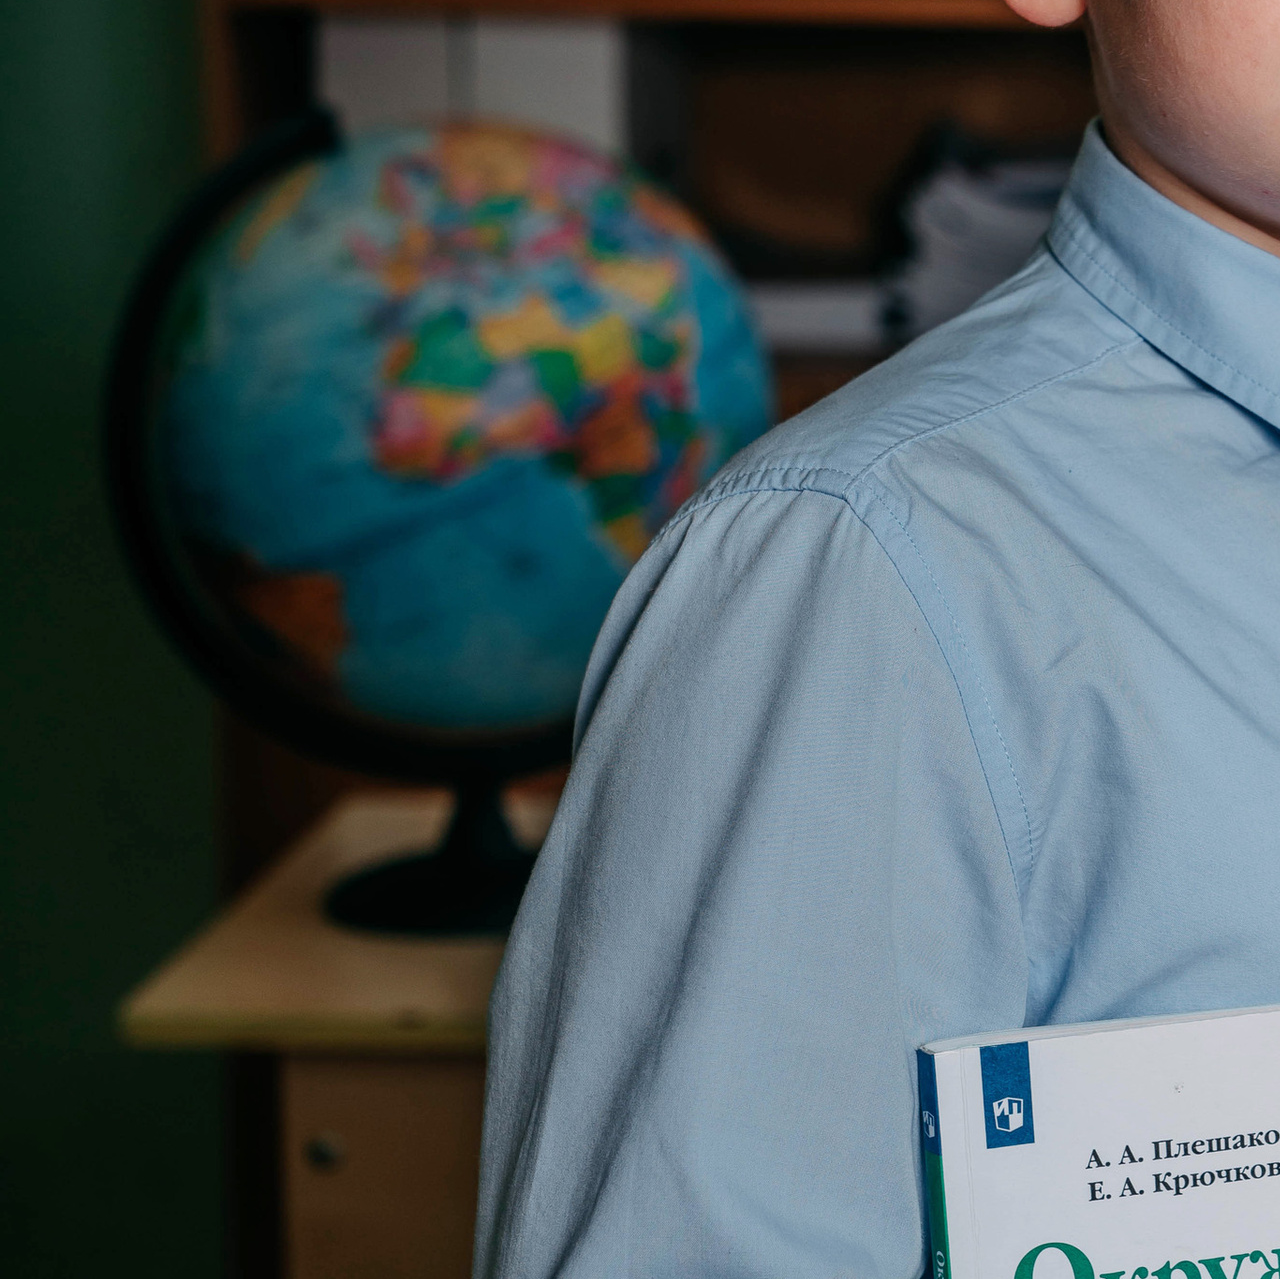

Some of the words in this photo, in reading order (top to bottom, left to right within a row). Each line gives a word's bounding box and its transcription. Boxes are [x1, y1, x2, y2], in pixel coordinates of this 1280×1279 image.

[1085, 1148, 1111, 1169] А.
[1118, 1144, 1144, 1165] А.
[1088, 1181, 1112, 1201] Е.
[1119, 1177, 1145, 1198] А.
